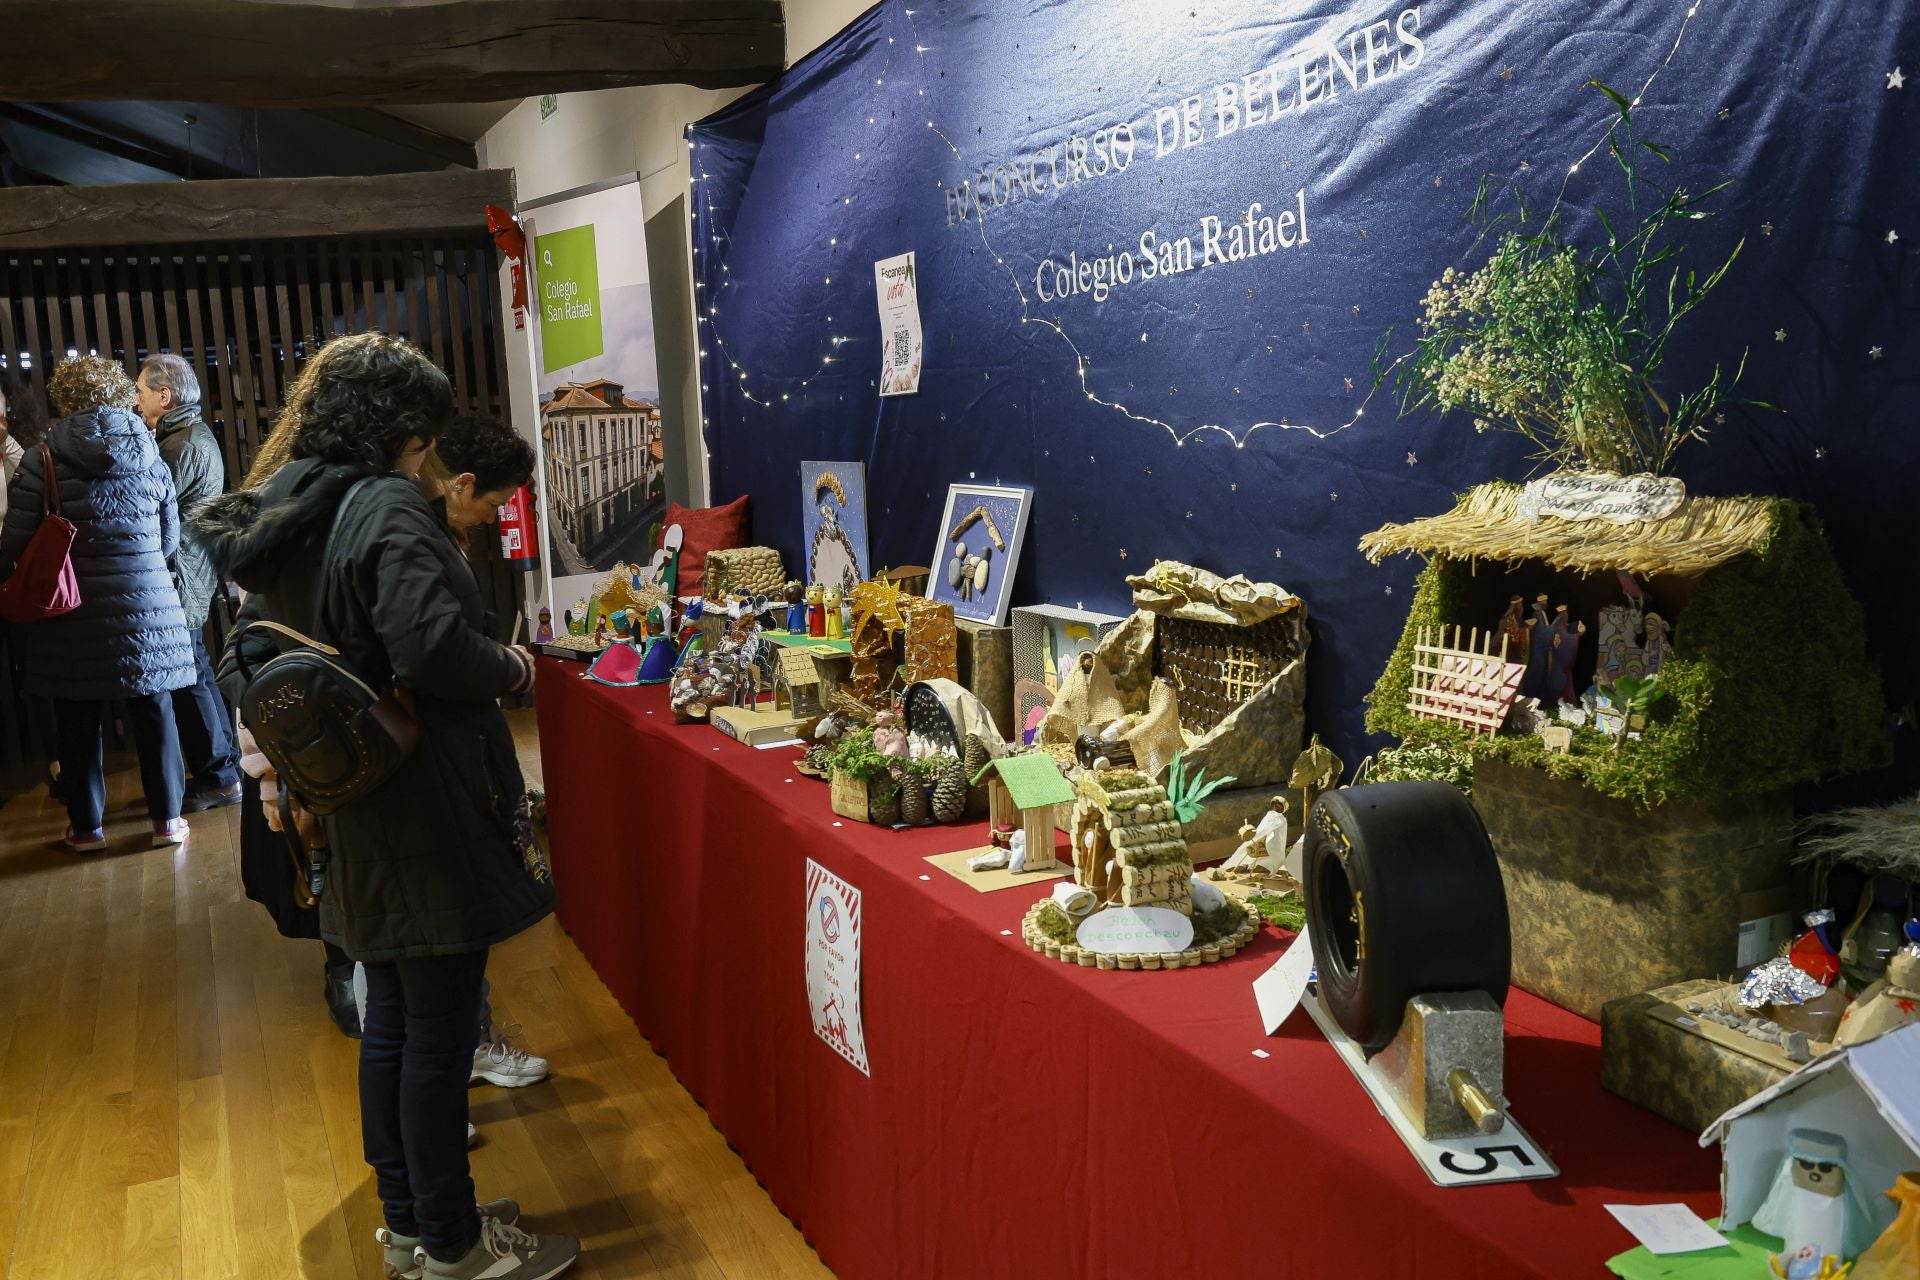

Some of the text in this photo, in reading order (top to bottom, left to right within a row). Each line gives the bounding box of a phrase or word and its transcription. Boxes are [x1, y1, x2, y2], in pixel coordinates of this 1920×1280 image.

[945, 6, 1425, 227] IV CONCURSO DE BELENES
[1036, 189, 1310, 302] Colegio San Rafael
[546, 276, 578, 302] Colegio
[547, 303, 564, 322] San
[565, 298, 593, 320] Rafael
[818, 938, 845, 965] POR FAVOR
[827, 959, 835, 972] NO
[823, 970, 839, 989] TOCAR
